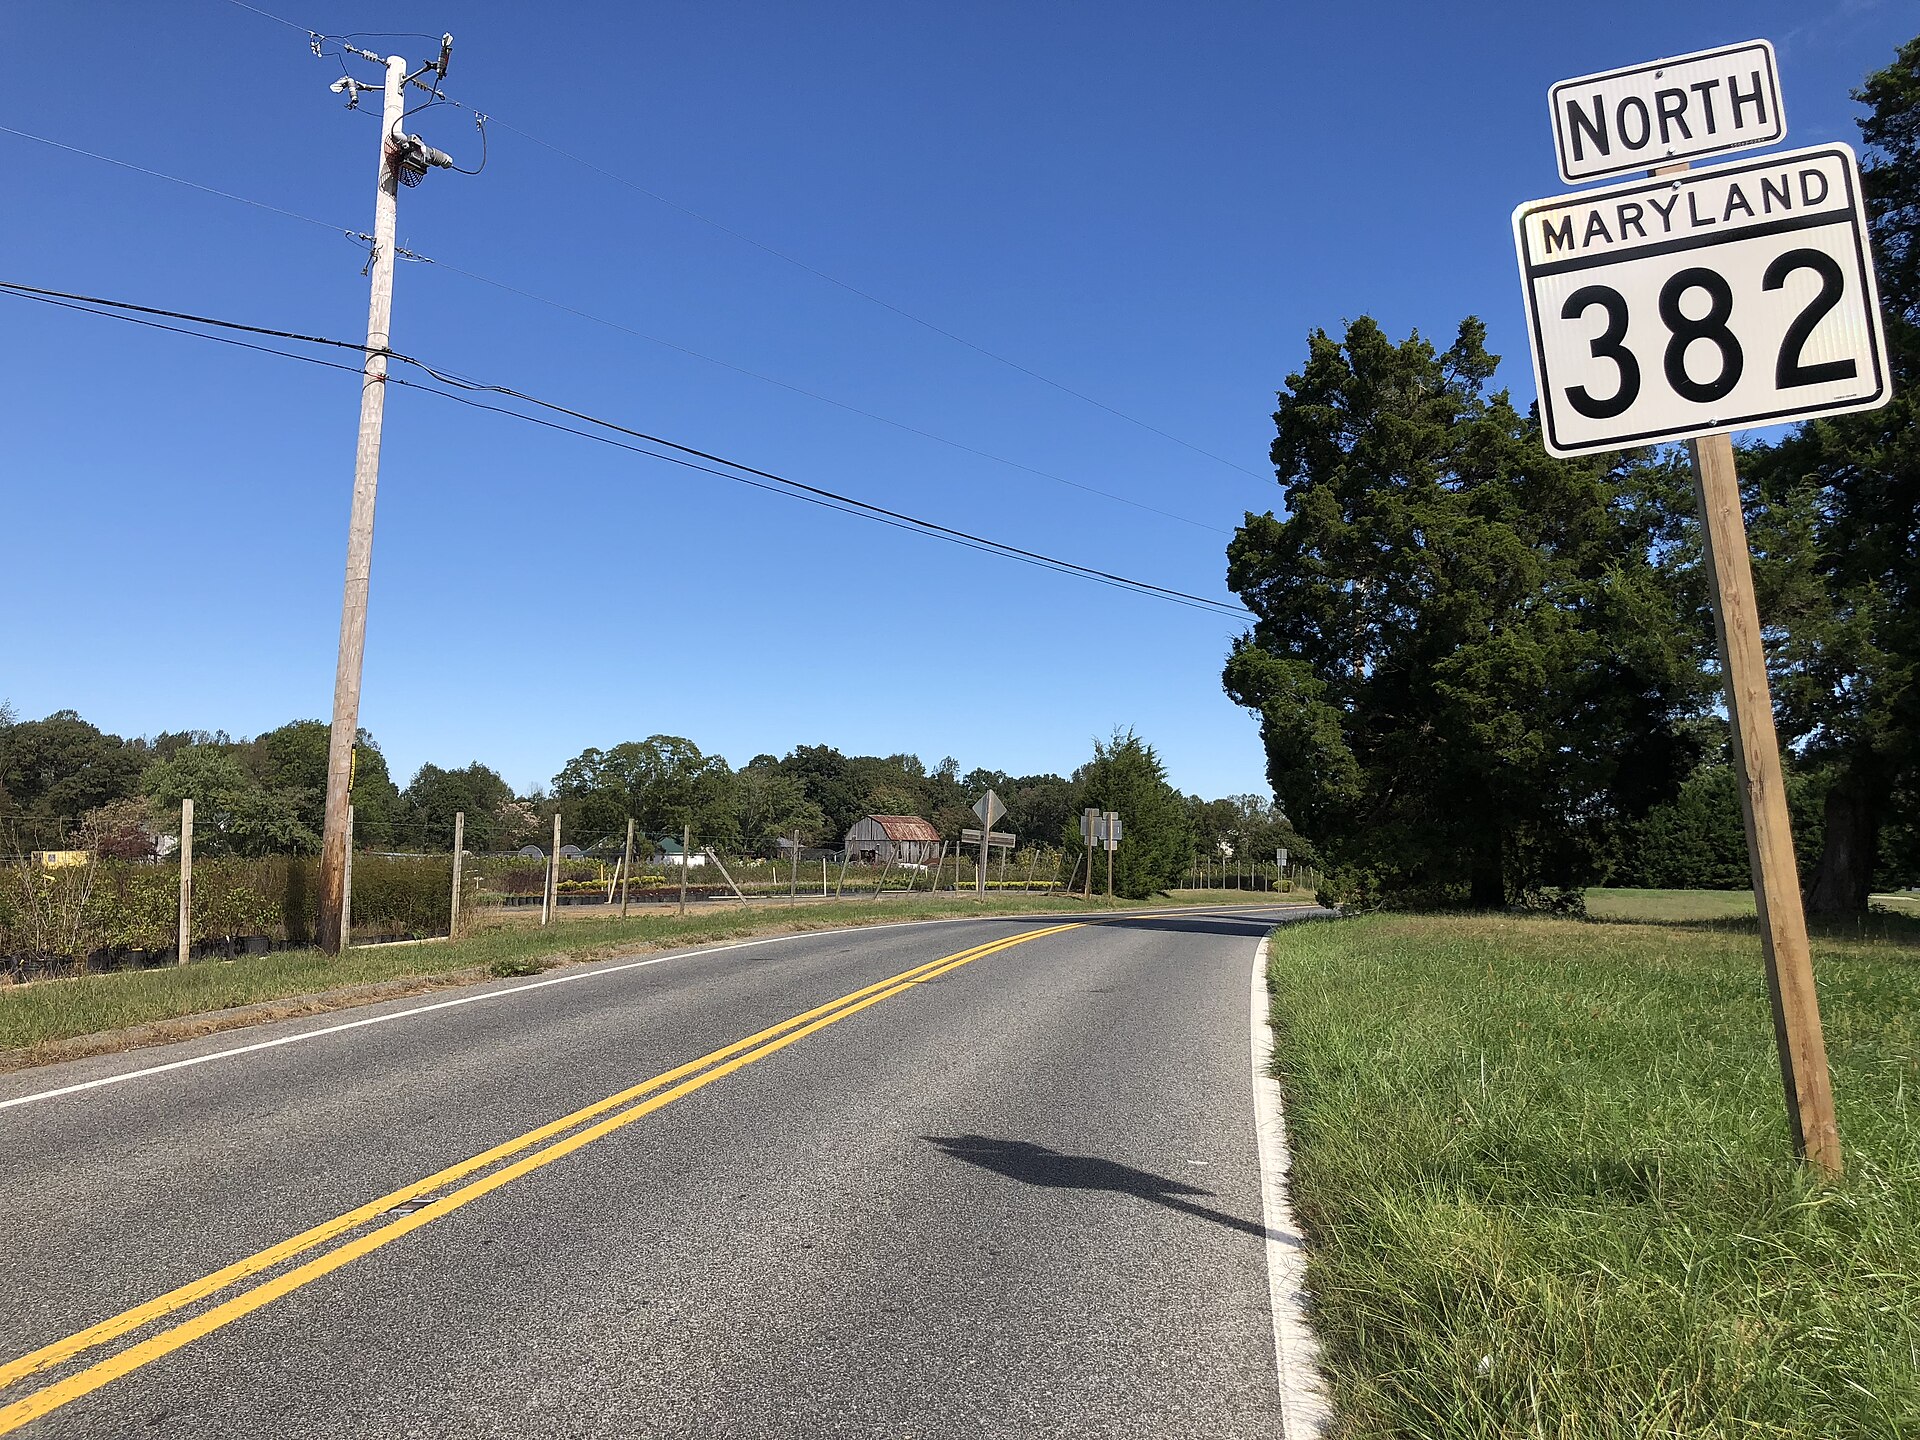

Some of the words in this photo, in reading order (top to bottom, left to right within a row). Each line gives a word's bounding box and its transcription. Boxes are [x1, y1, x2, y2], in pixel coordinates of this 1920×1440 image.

[1566, 70, 1768, 162] NORTH
[1542, 168, 1829, 254] MARYLAND
[1560, 247, 1858, 420] 382
